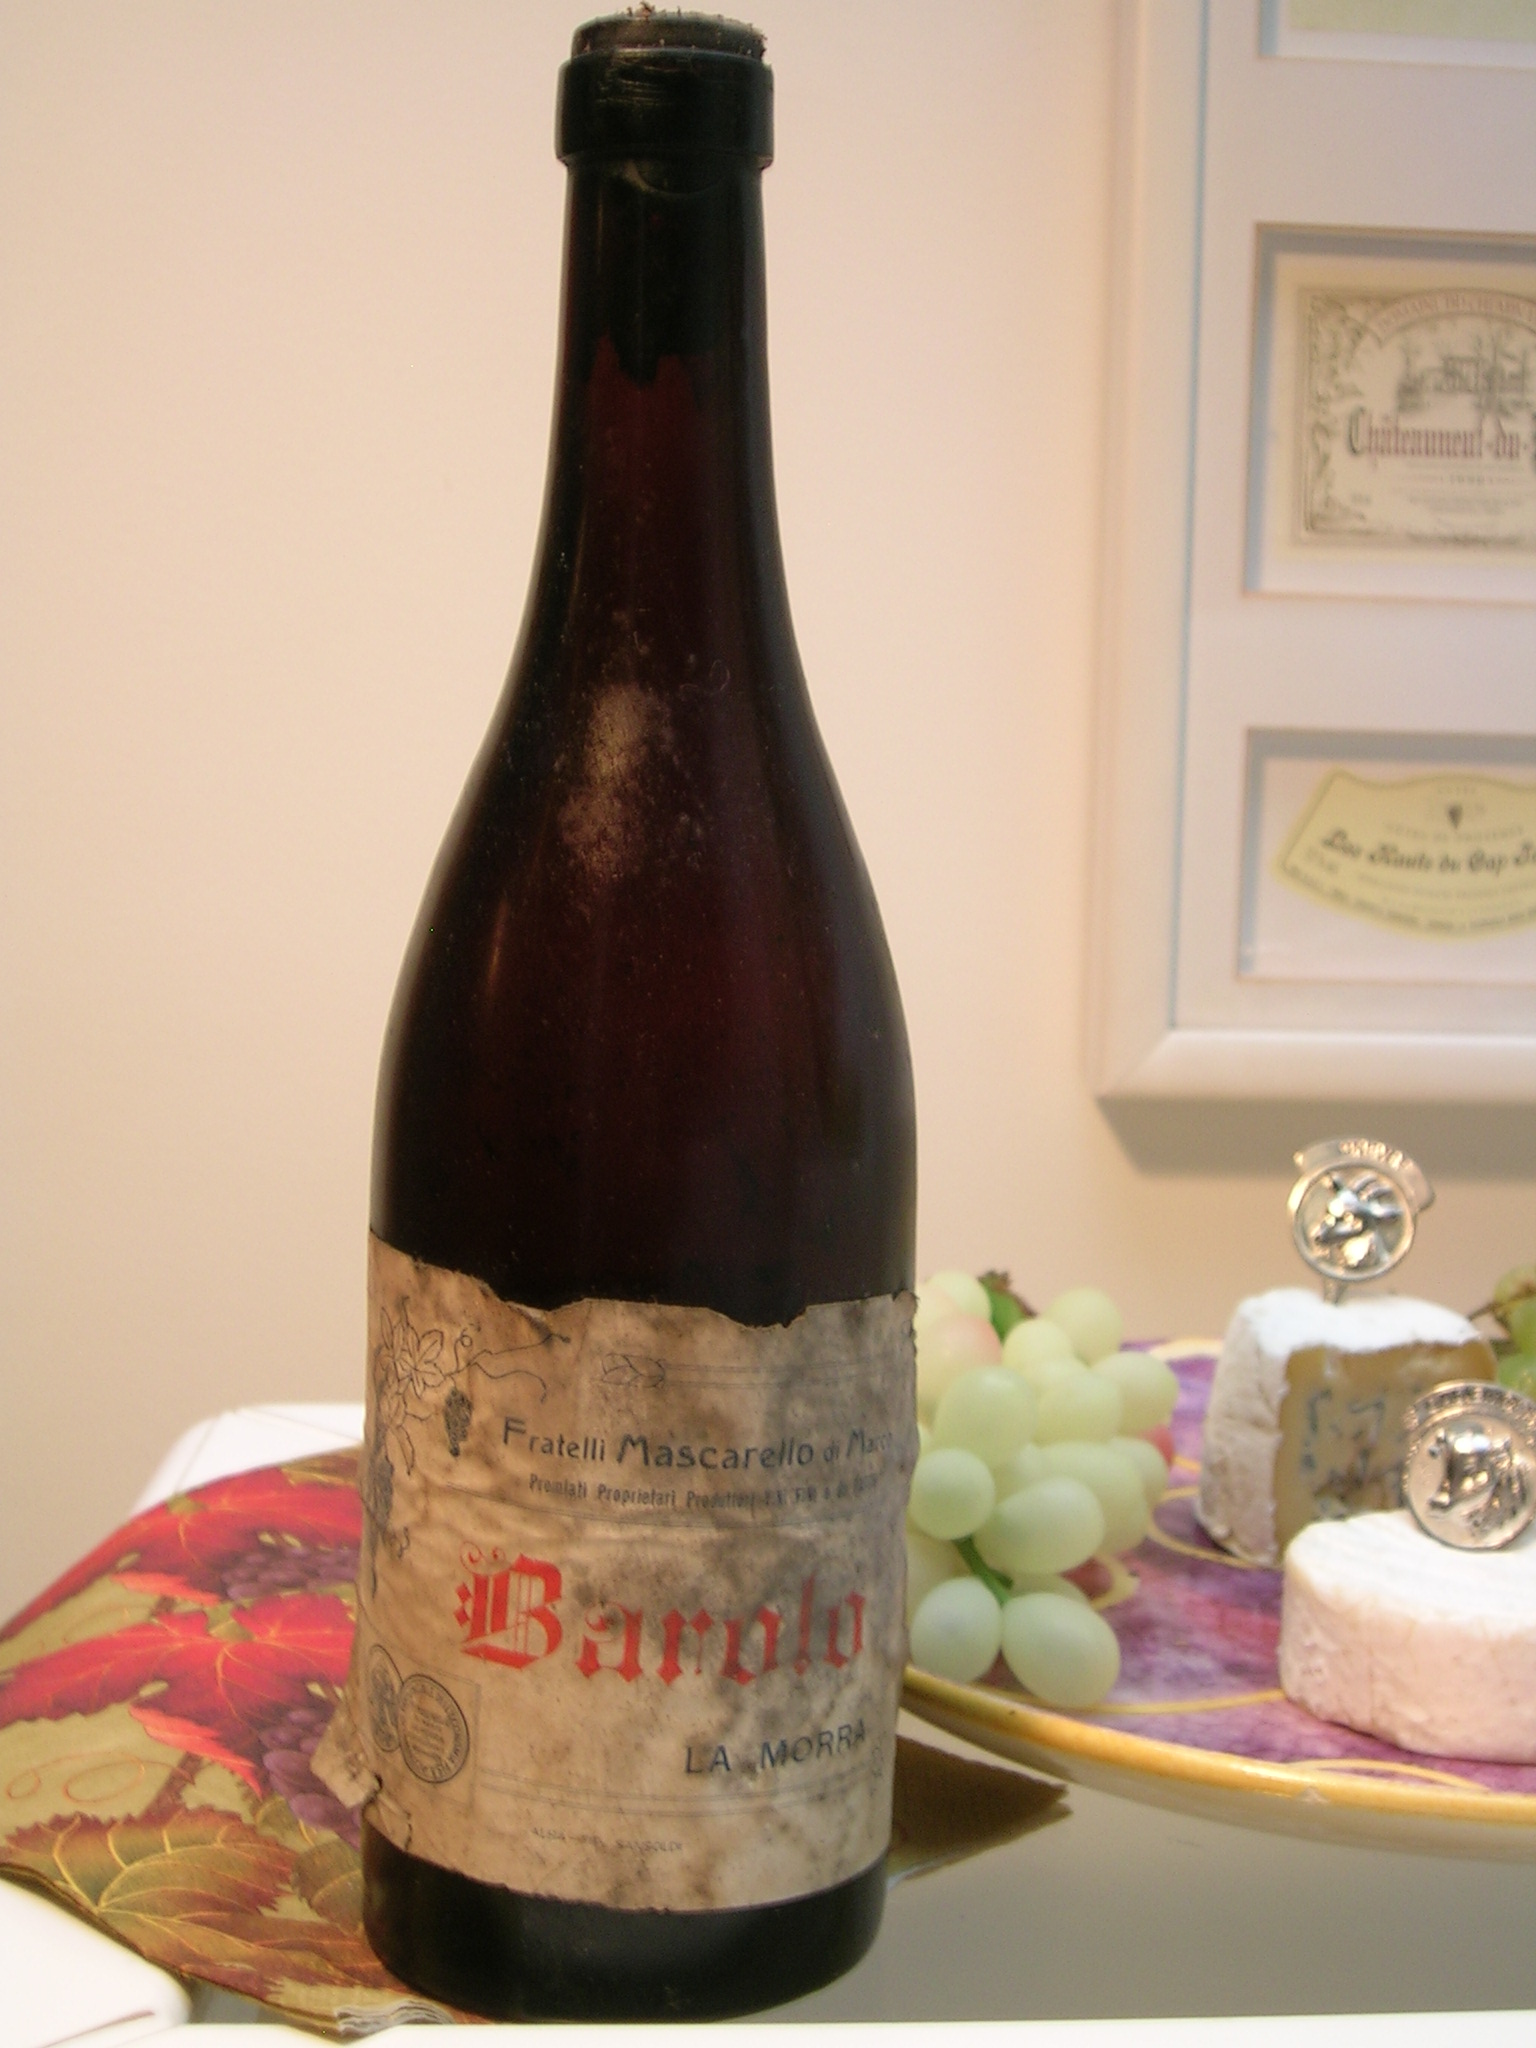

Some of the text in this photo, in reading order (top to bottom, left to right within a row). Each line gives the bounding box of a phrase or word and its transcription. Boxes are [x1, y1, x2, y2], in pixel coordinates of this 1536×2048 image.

[502, 1416, 606, 1463] Fratelli
[616, 1433, 814, 1470] Mascarello
[822, 1439, 841, 1463] di
[598, 1483, 678, 1508] Proprietari
[452, 1540, 867, 1687] Barolo
[685, 1718, 867, 1774] LA MORRA
